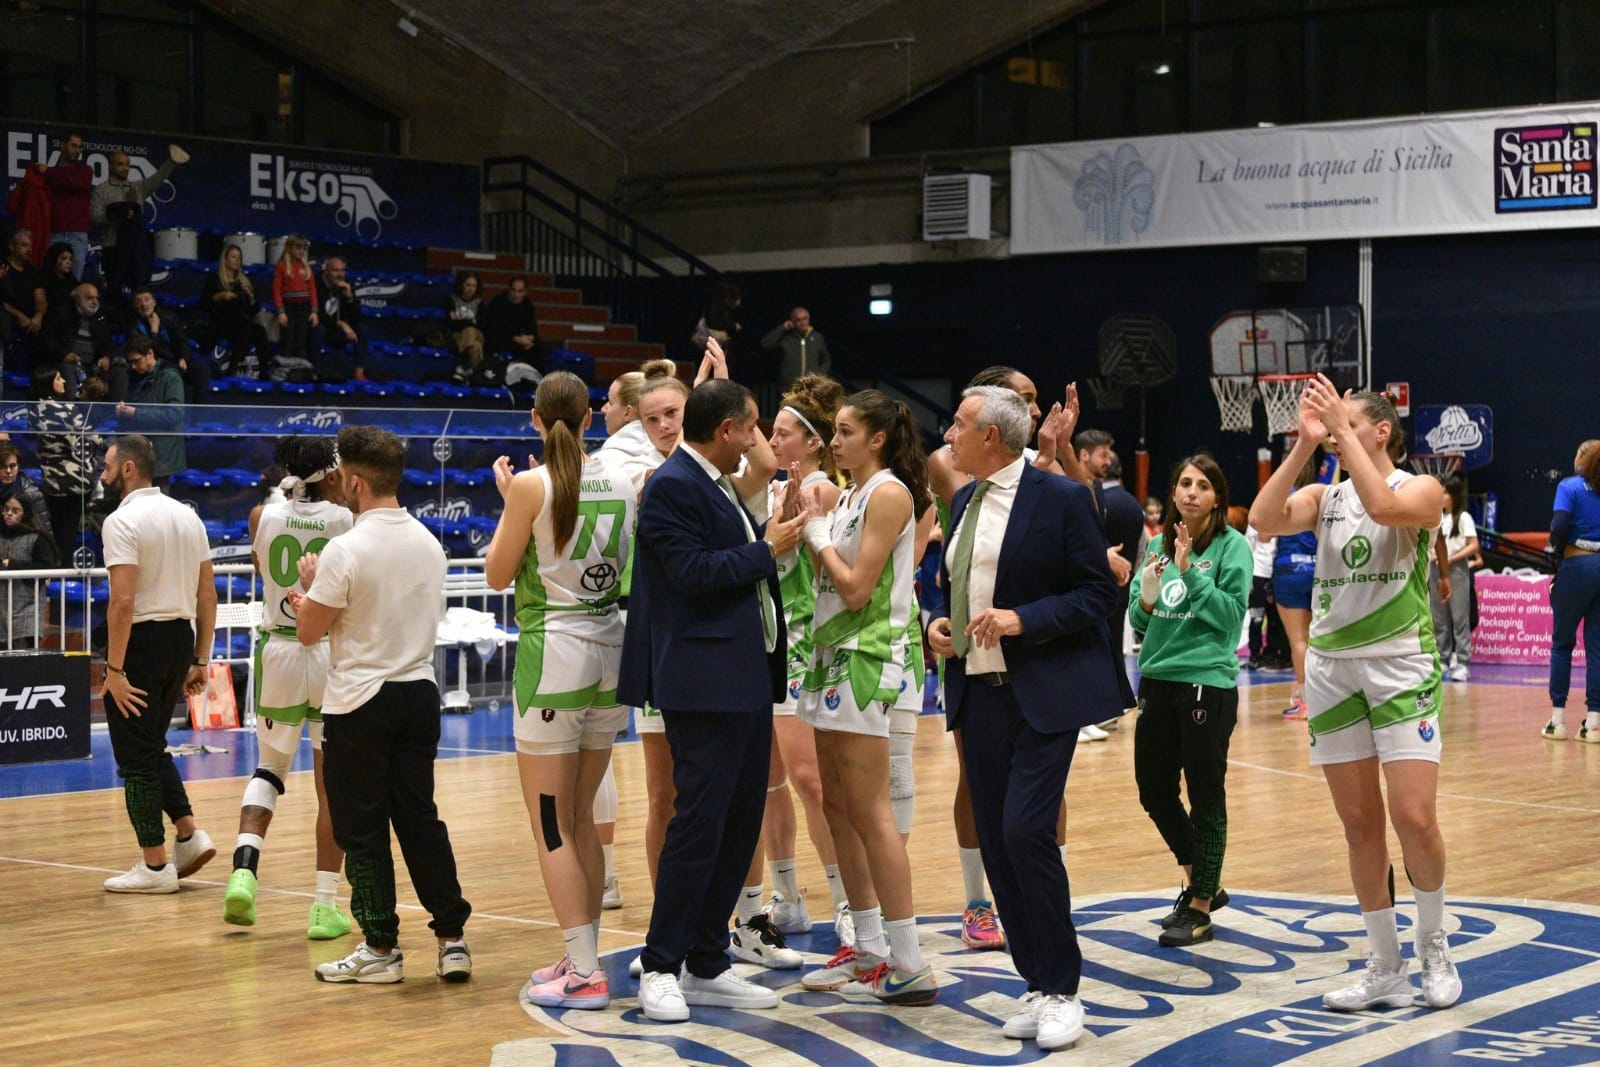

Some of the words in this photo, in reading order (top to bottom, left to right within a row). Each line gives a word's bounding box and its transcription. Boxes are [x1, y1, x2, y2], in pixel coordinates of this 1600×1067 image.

[1500, 130, 1592, 166] Santa
[1196, 160, 1225, 183] La
[1233, 157, 1290, 182] buona
[1298, 159, 1356, 184] acqua
[1364, 149, 1384, 174] di
[1389, 145, 1453, 172] Sicilia
[250, 153, 339, 204] Ekso
[1499, 162, 1593, 199] Maria
[1264, 196, 1379, 212] www.acquasantamaria.it
[580, 479, 612, 493] NIKOLIC
[286, 516, 326, 531] THOMAS
[570, 499, 626, 560] 77
[1312, 570, 1406, 589] Passalacqua
[1483, 588, 1541, 601] Biotecnologie
[1480, 603, 1516, 616] Impianti
[1478, 617, 1524, 630] Packaging
[1478, 630, 1507, 641] Analisi
[1523, 648, 1529, 656] e
[21, 725, 68, 742] IBRIDO.
